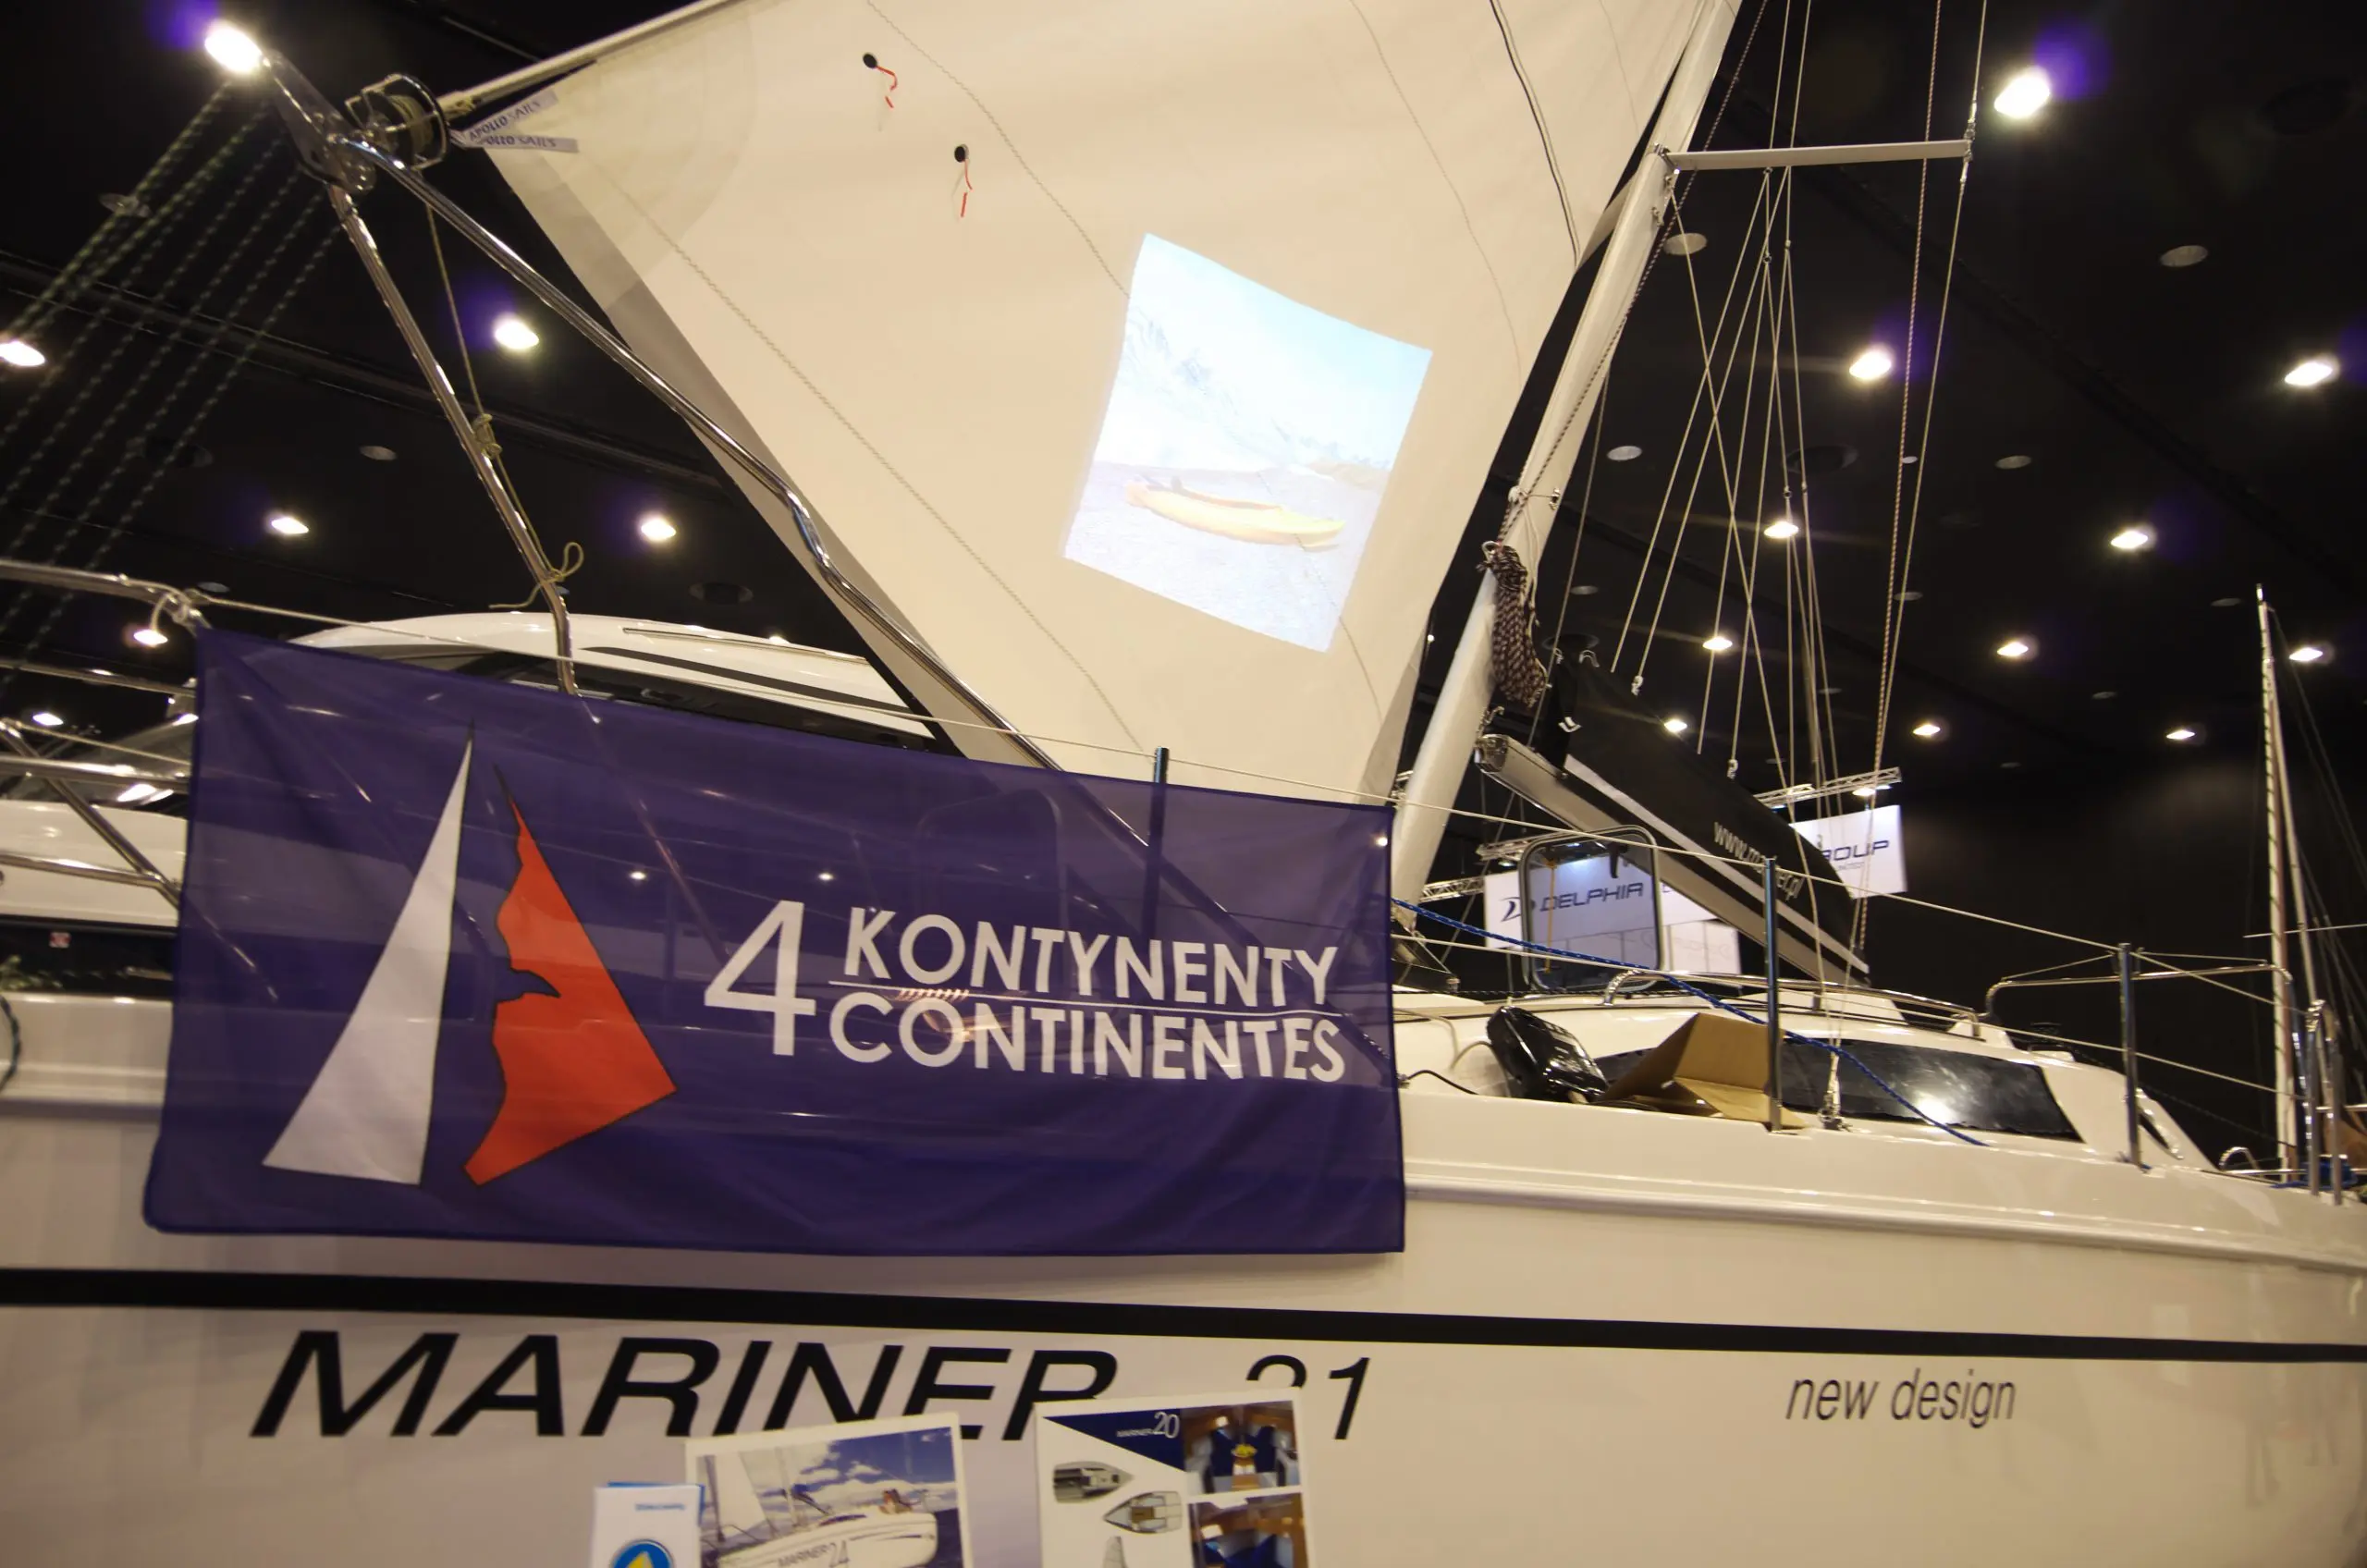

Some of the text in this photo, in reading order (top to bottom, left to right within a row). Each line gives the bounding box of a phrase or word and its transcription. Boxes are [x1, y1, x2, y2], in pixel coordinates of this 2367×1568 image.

[469, 116, 508, 141] APOLLO
[1821, 839, 1889, 862] ROUP
[1539, 882, 1644, 912] DELPHIA
[704, 900, 1339, 1056] 4 KONTYNENTY
[829, 992, 1346, 1083] CONTINENTES
[1784, 1367, 2016, 1428] new design
[1154, 1411, 1180, 1439] 20
